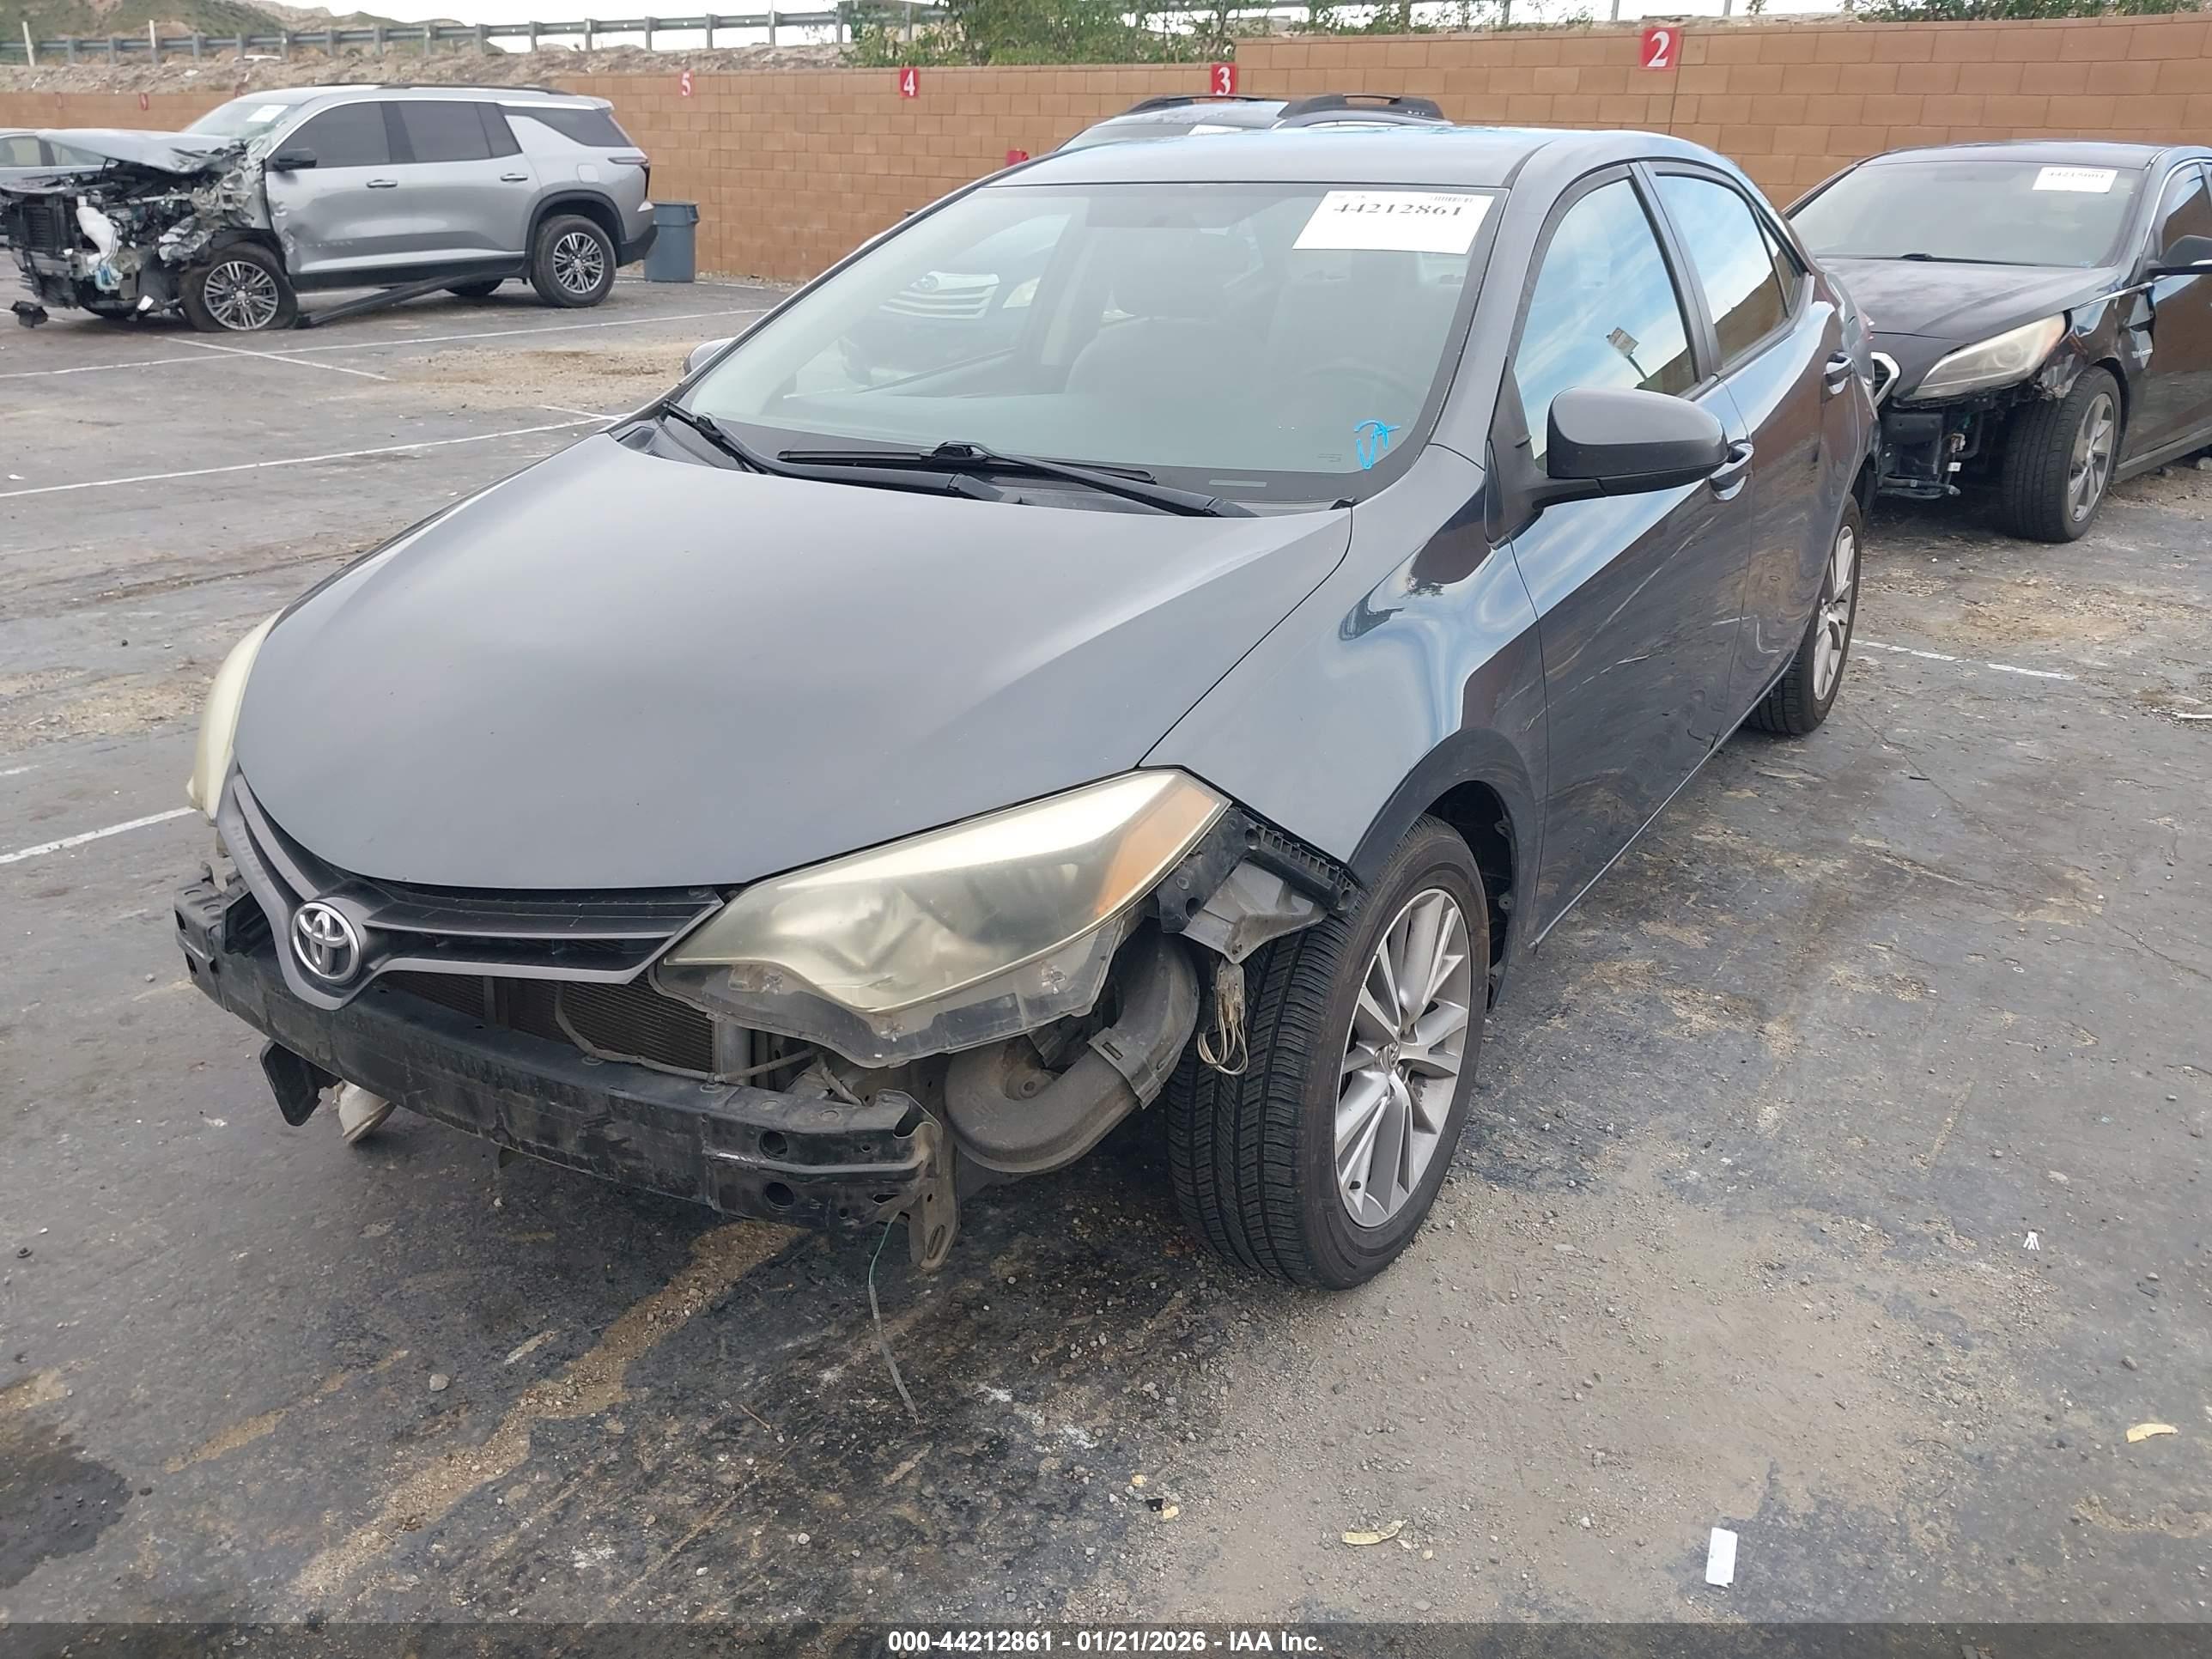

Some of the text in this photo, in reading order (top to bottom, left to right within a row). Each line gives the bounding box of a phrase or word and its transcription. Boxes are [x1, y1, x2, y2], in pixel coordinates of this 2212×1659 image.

[1647, 31, 1669, 67] 2
[682, 72, 691, 96] 5
[903, 70, 915, 96] 4
[1215, 66, 1231, 96] 3
[1334, 203, 1462, 216] 44212861
